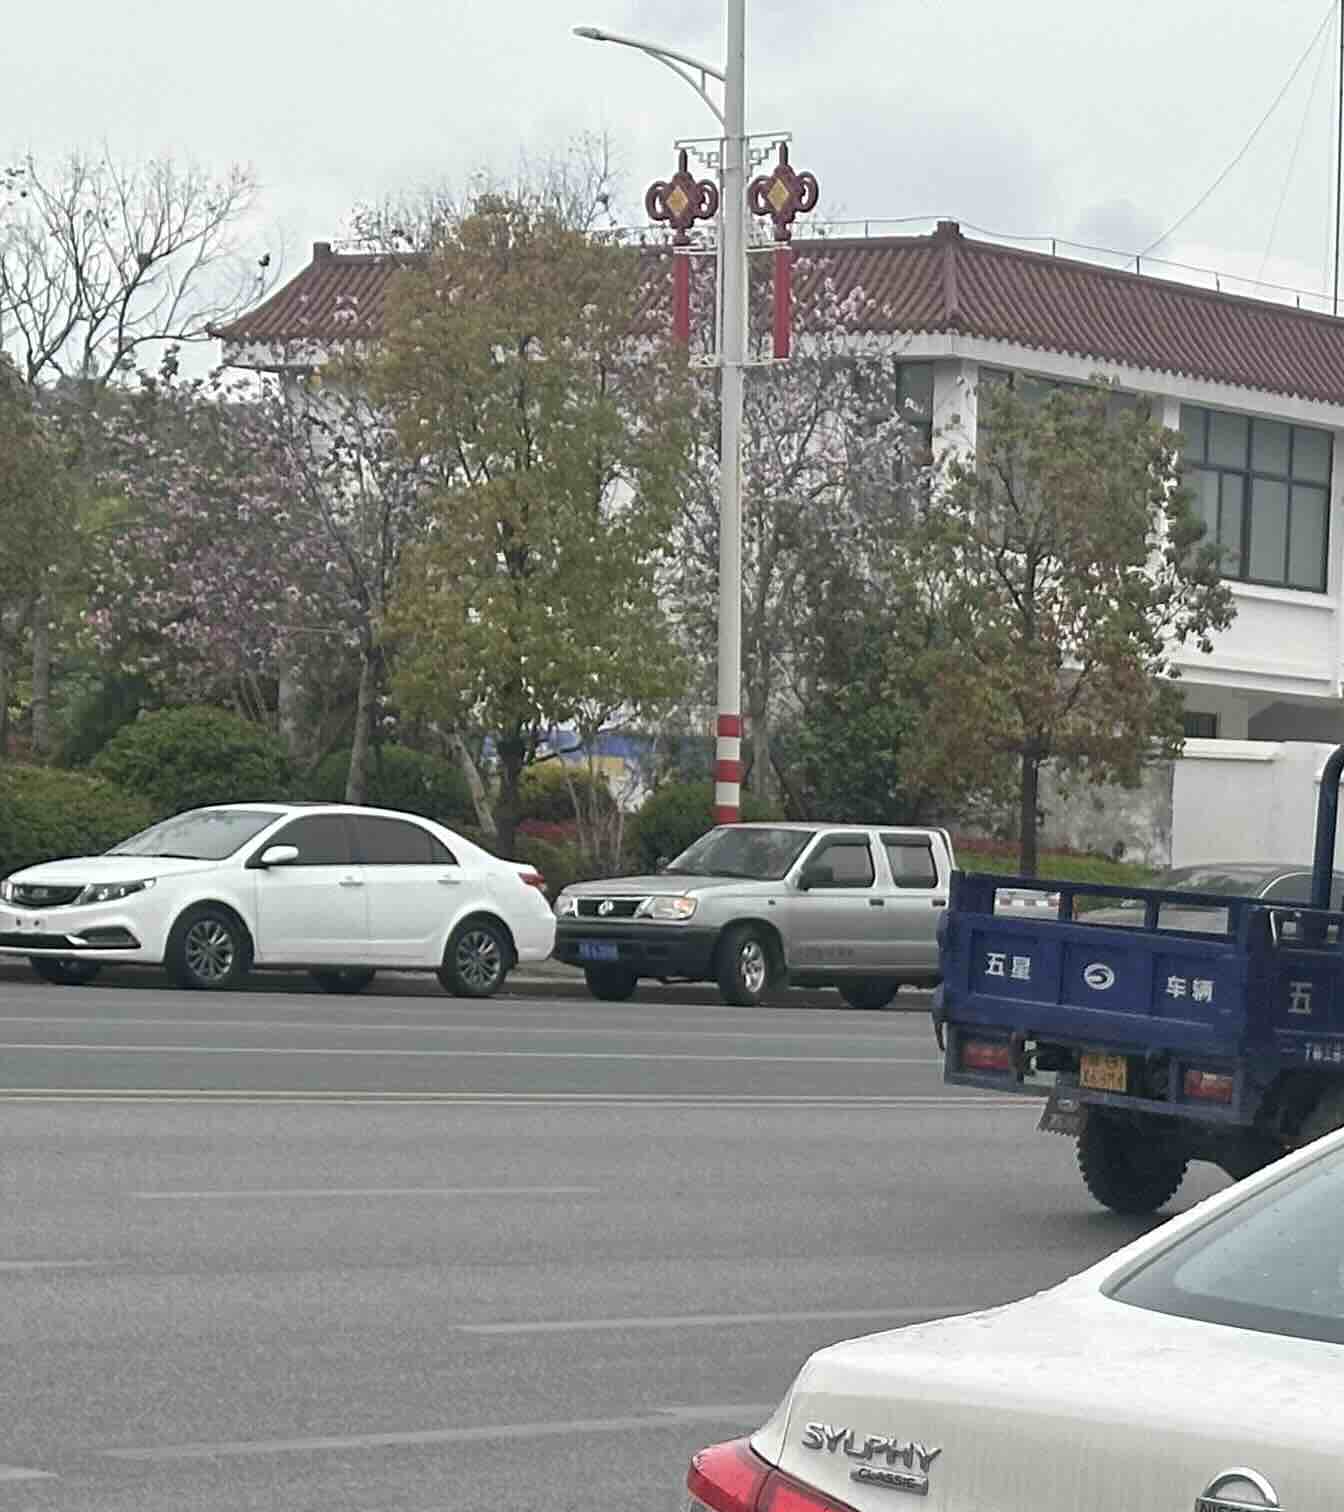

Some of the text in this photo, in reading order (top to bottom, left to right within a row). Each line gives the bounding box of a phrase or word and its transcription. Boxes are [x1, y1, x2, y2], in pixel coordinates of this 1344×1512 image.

[984, 953, 1214, 1003] 五星 车辆
[801, 1422, 943, 1474] SYLPHY
